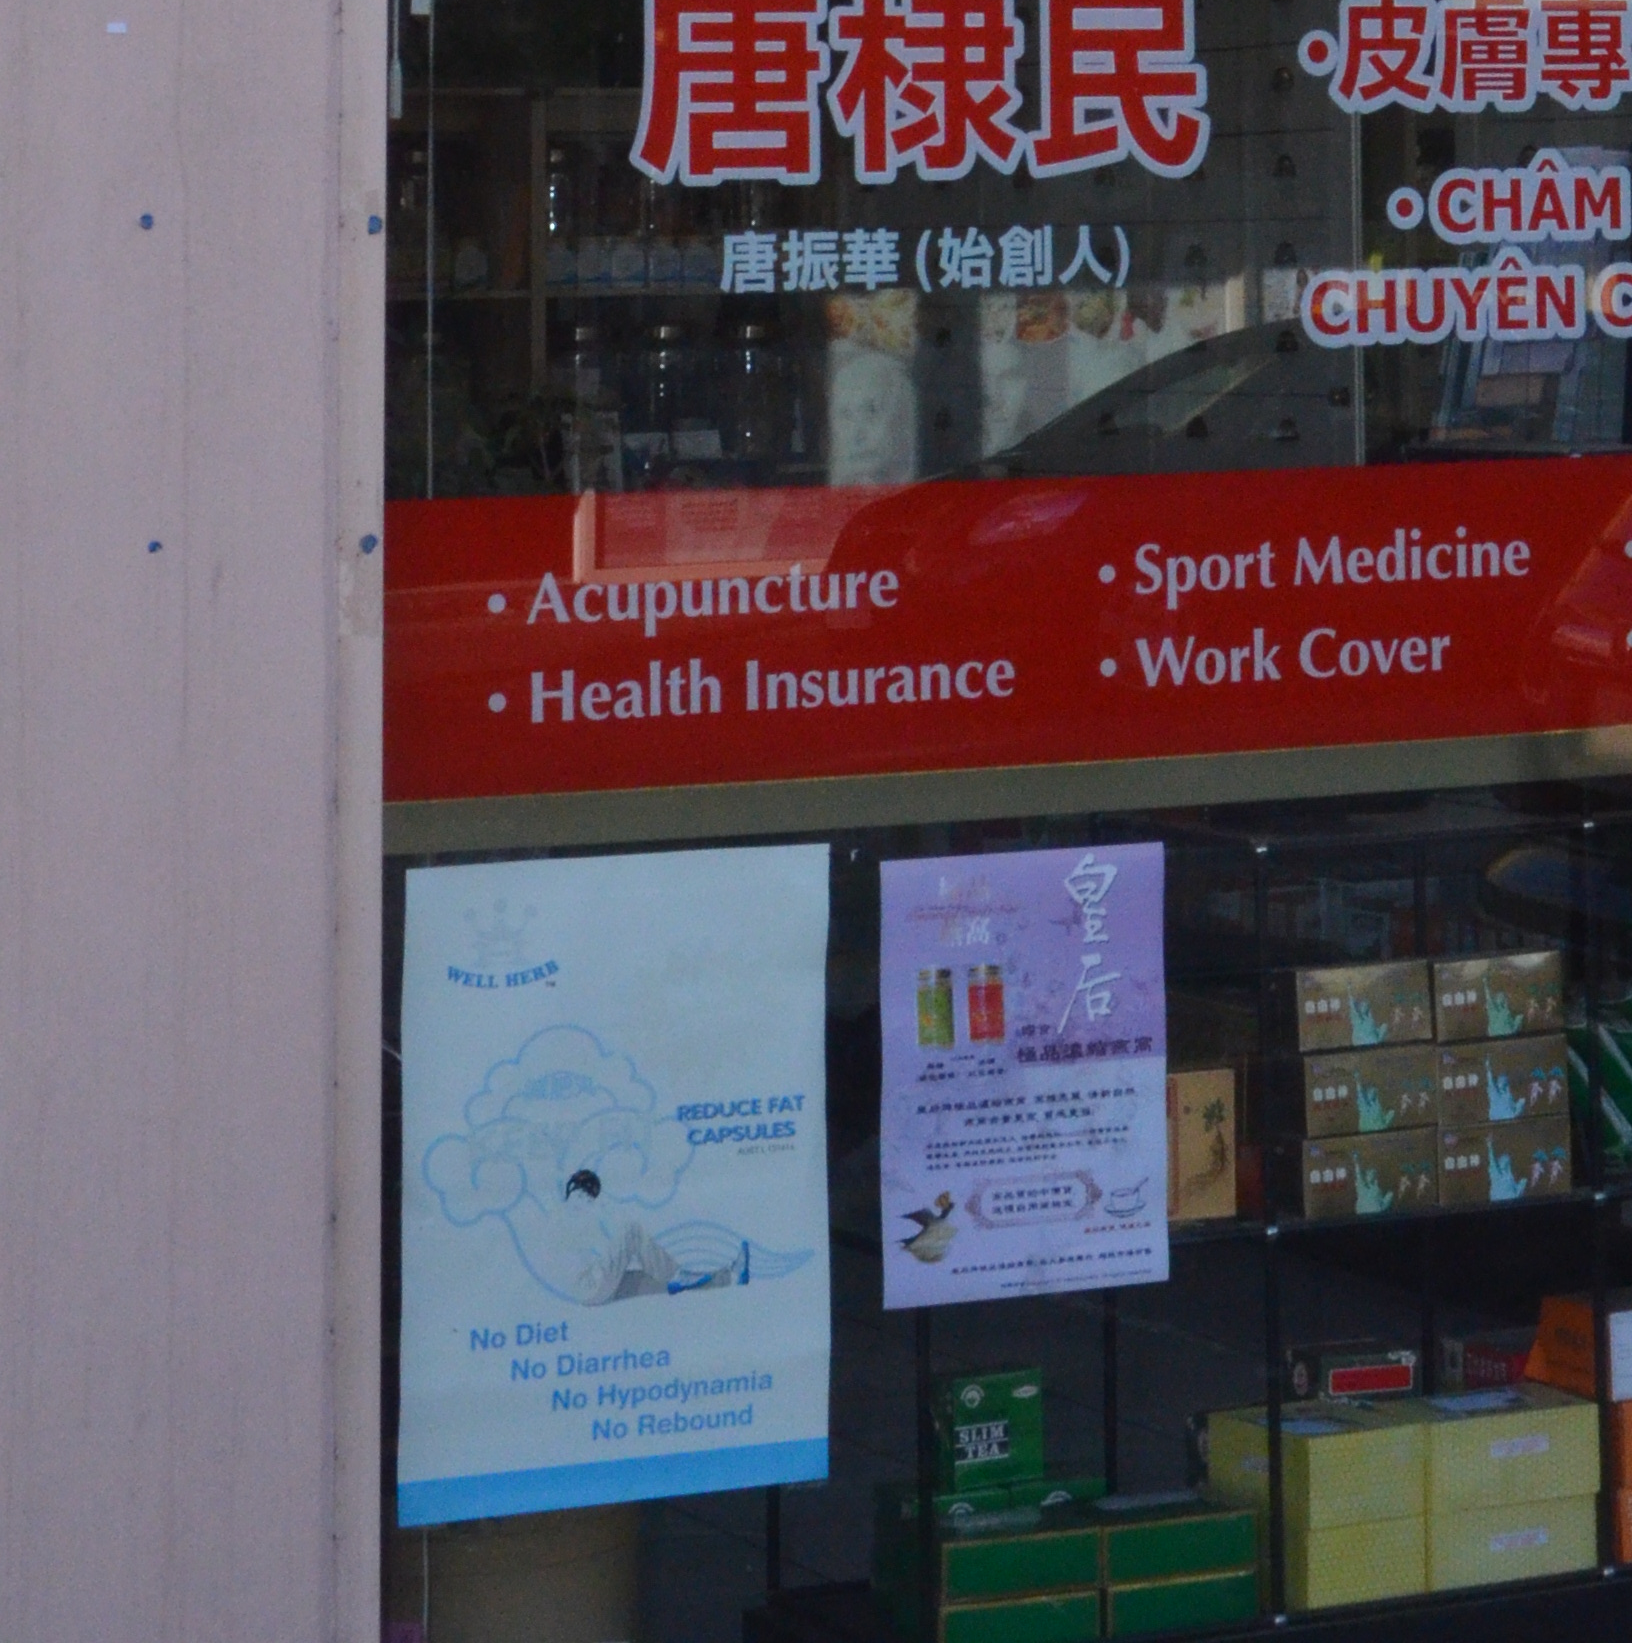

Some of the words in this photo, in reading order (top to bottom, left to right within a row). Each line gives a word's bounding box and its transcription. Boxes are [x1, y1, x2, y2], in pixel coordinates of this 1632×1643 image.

[1435, 157, 1624, 235] CHÂM
[1308, 257, 1577, 336] CHUYÊN
[1134, 539, 1278, 613] Sport
[1295, 525, 1531, 589] Medicine
[526, 567, 899, 637] Acupuncture
[1135, 627, 1279, 689] Work
[1299, 627, 1451, 680] Cover
[530, 657, 721, 724] Health
[745, 653, 1016, 713] Insurance
[447, 965, 499, 989] WELL
[505, 959, 560, 987] HERB
[677, 1098, 763, 1122] REDUCE
[767, 1094, 806, 1115] FAT
[687, 1121, 797, 1147] CAPSULES
[470, 1328, 507, 1351] No
[516, 1321, 569, 1347] Diet
[510, 1359, 547, 1381] No
[557, 1349, 671, 1377] Diarrhea
[551, 1389, 588, 1412] No
[597, 1369, 773, 1411] Hypodynamia
[591, 1419, 628, 1441] No
[637, 1404, 754, 1437] Rebound
[959, 1424, 1005, 1444] SLIM
[965, 1442, 1001, 1459] TEA
